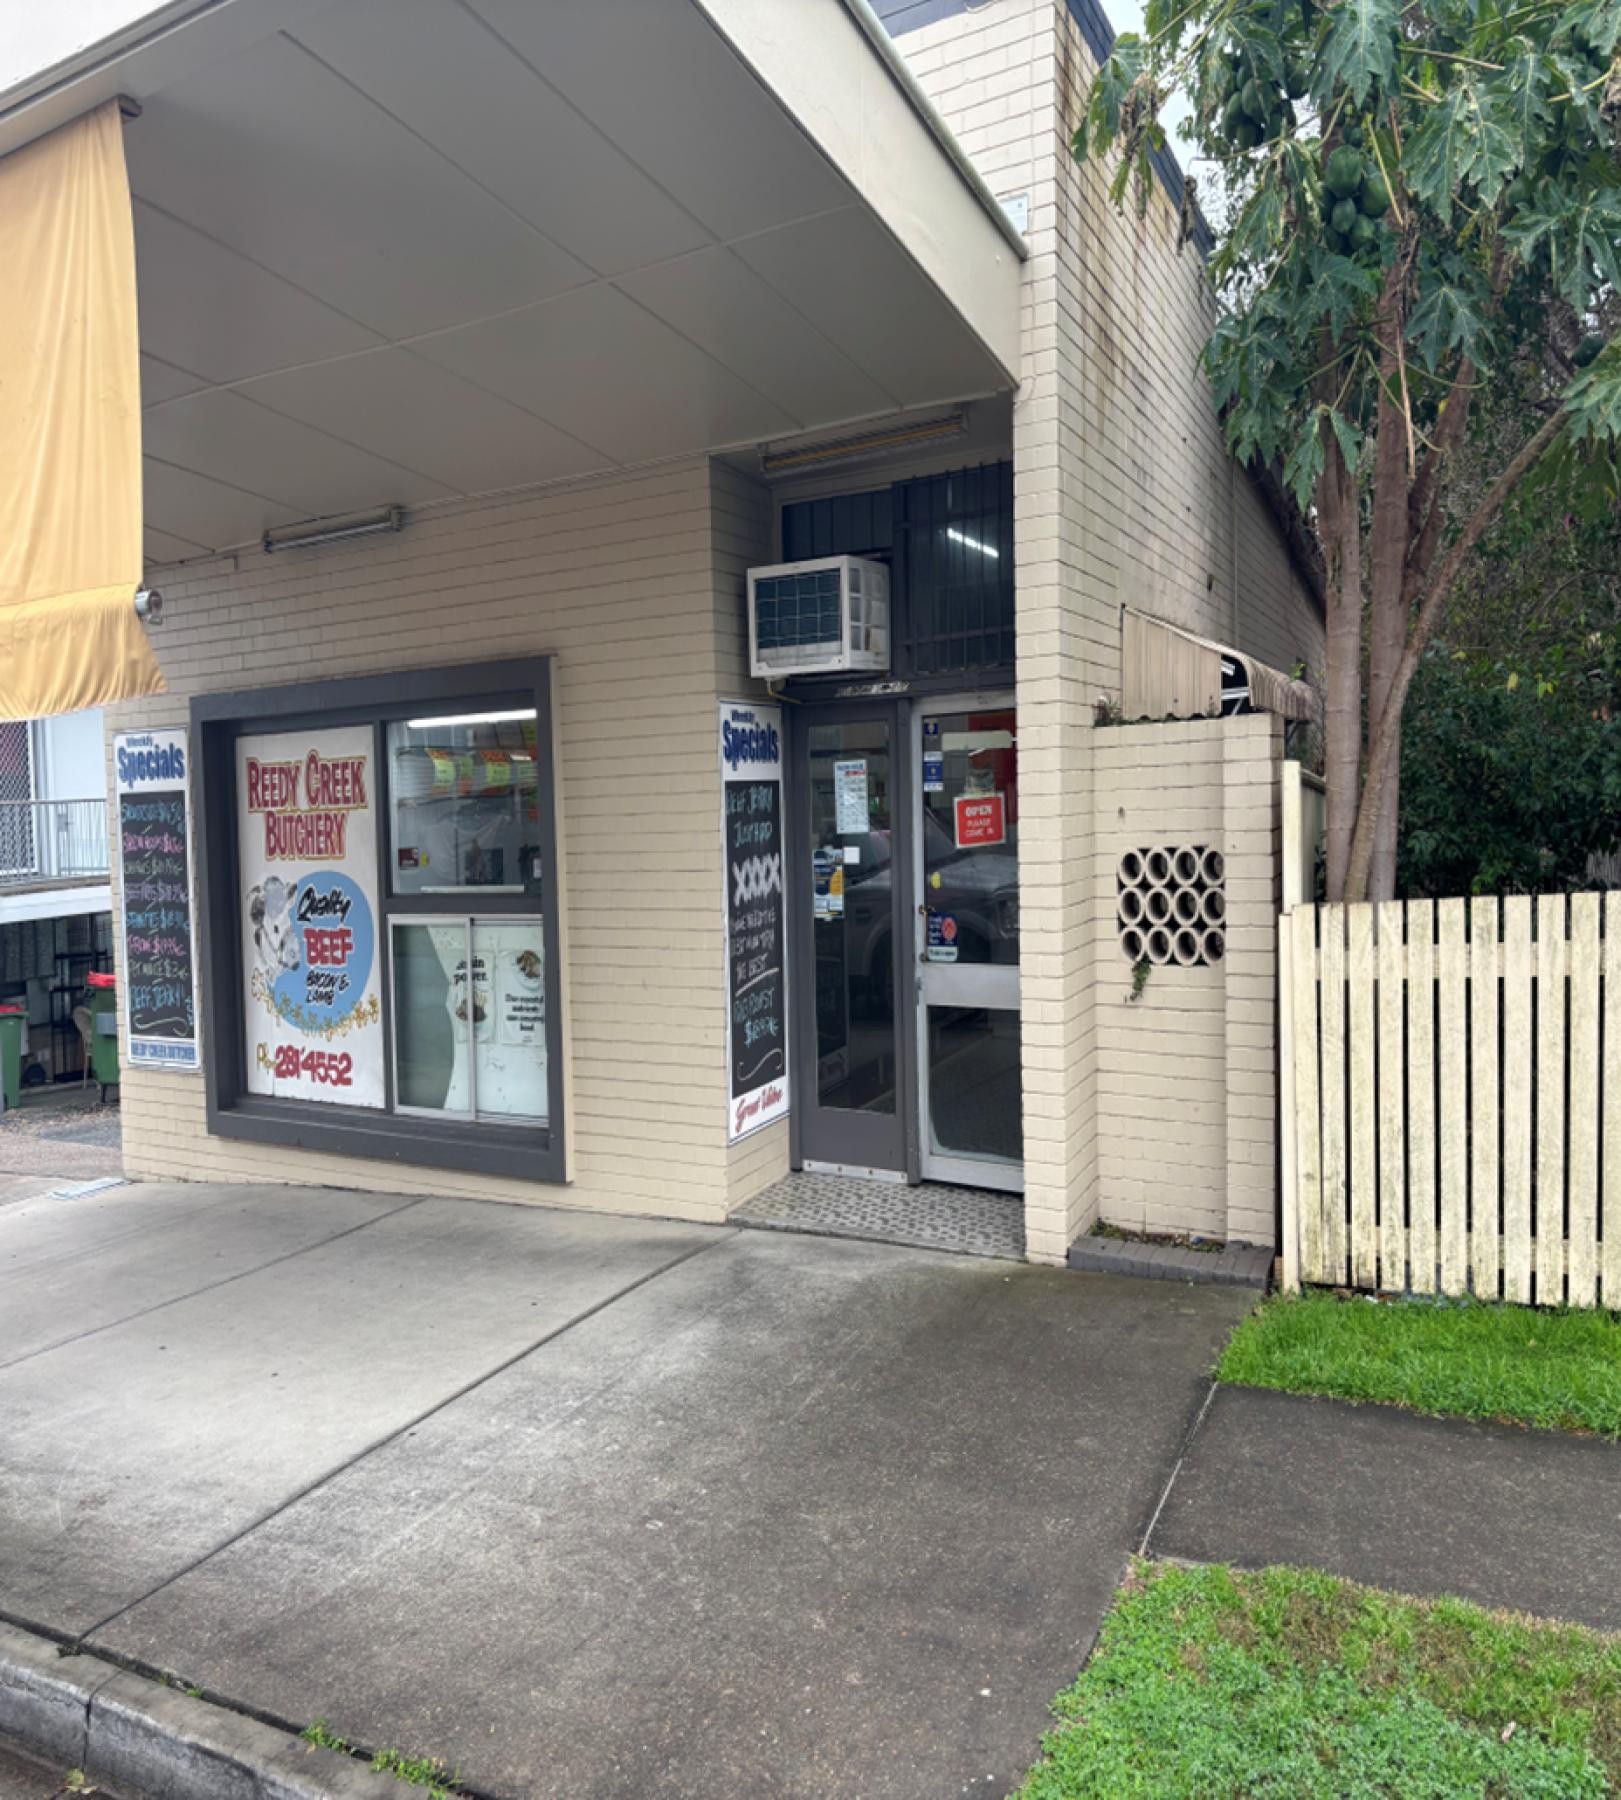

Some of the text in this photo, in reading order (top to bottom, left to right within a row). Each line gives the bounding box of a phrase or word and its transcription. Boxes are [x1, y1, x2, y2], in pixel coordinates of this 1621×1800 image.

[118, 742, 184, 789] Specials
[723, 719, 779, 771] Specials
[247, 752, 367, 809] REEDY CREEK
[265, 810, 346, 859] BUTCHERY
[965, 804, 993, 818] OPEN
[732, 852, 783, 907] XXXX
[297, 886, 352, 923] Quality
[303, 927, 353, 966] BEEF
[306, 970, 337, 988] BACON
